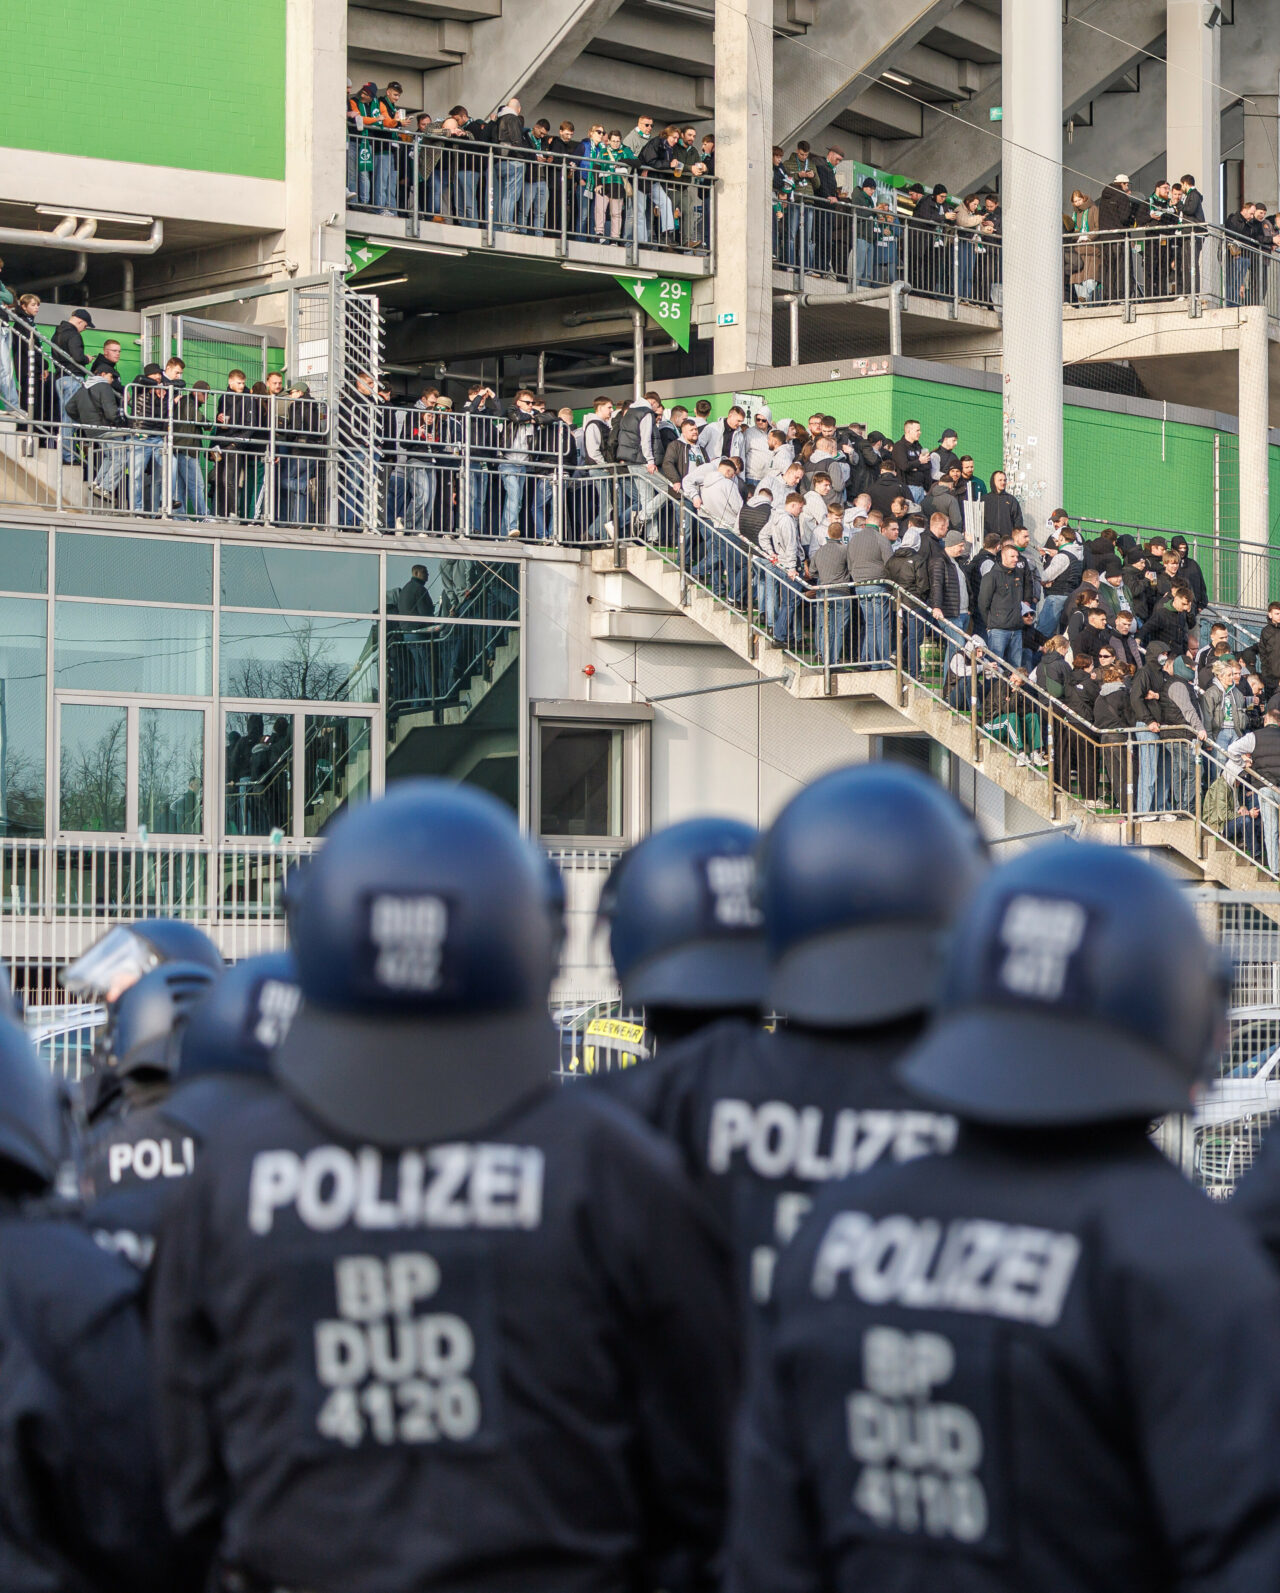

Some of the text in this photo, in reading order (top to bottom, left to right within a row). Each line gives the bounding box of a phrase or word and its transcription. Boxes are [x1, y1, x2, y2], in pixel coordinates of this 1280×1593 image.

[658, 301, 681, 319] 35
[660, 282, 687, 299] 29-
[109, 1137, 195, 1183] POLI
[249, 1143, 546, 1236] POLIZEI
[335, 1252, 441, 1321] BP
[811, 1210, 1081, 1327] POLIZEI
[314, 1312, 475, 1389] DUD
[862, 1324, 955, 1400] BP
[316, 1376, 481, 1447] 4120
[845, 1390, 984, 1472] DUD
[853, 1464, 988, 1543] 4110
